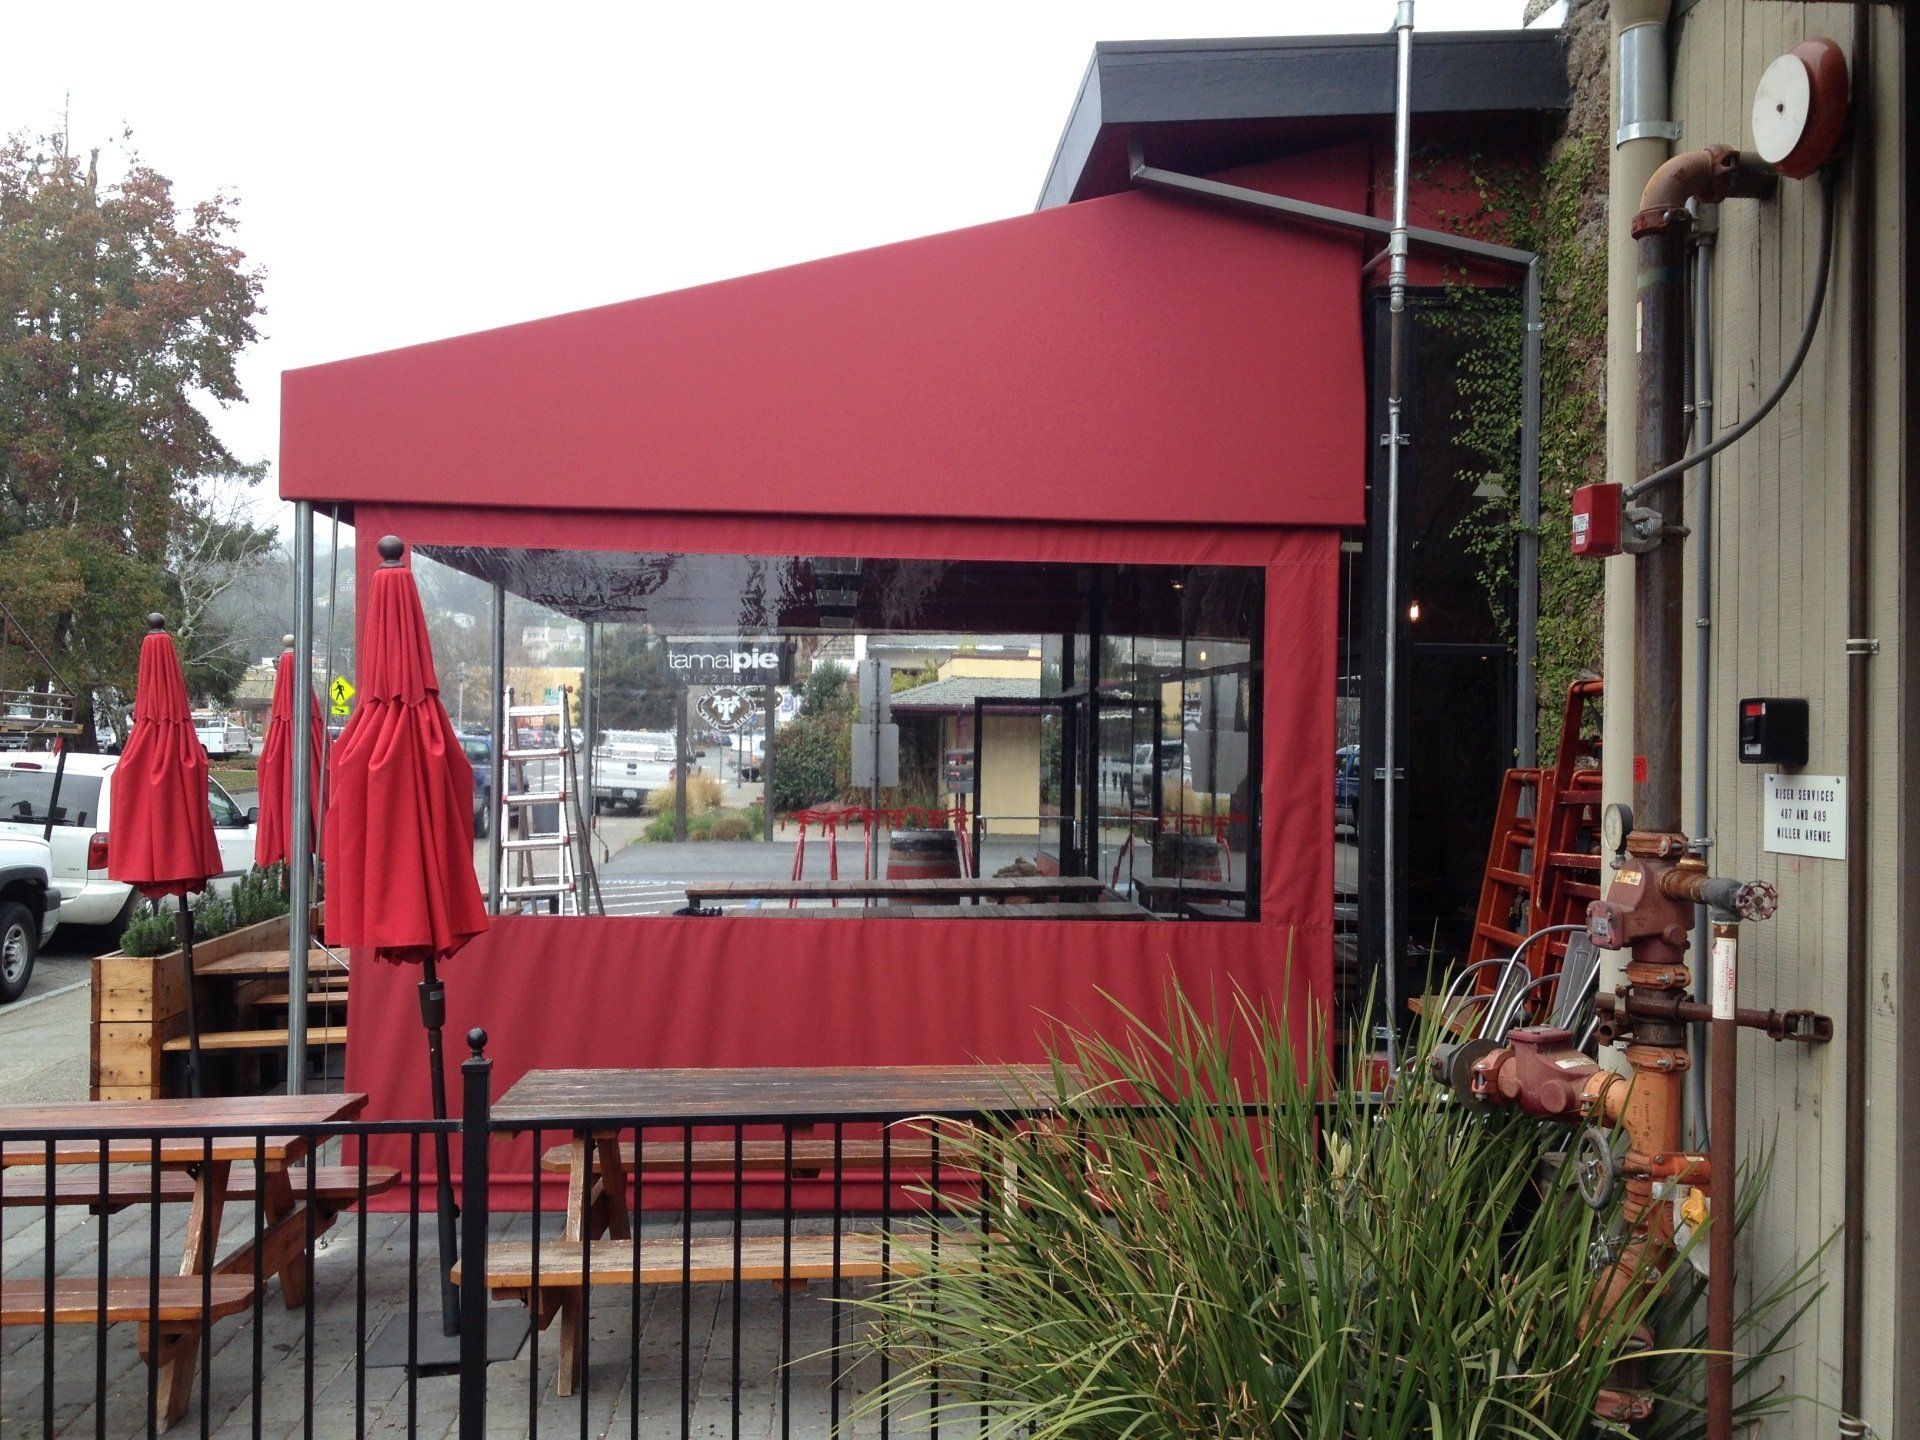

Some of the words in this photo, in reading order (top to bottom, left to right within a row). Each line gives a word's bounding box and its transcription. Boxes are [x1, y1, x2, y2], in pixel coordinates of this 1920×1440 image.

[667, 648, 780, 673] tamalpie
[1775, 788, 1794, 801] RISER
[1798, 789, 1834, 803] SERVICES
[1780, 808, 1792, 820] 487
[1796, 809, 1809, 821] AND
[1813, 810, 1827, 822] 489
[1776, 827, 1801, 840] MILLER
[1805, 829, 1831, 843] AVENUE
